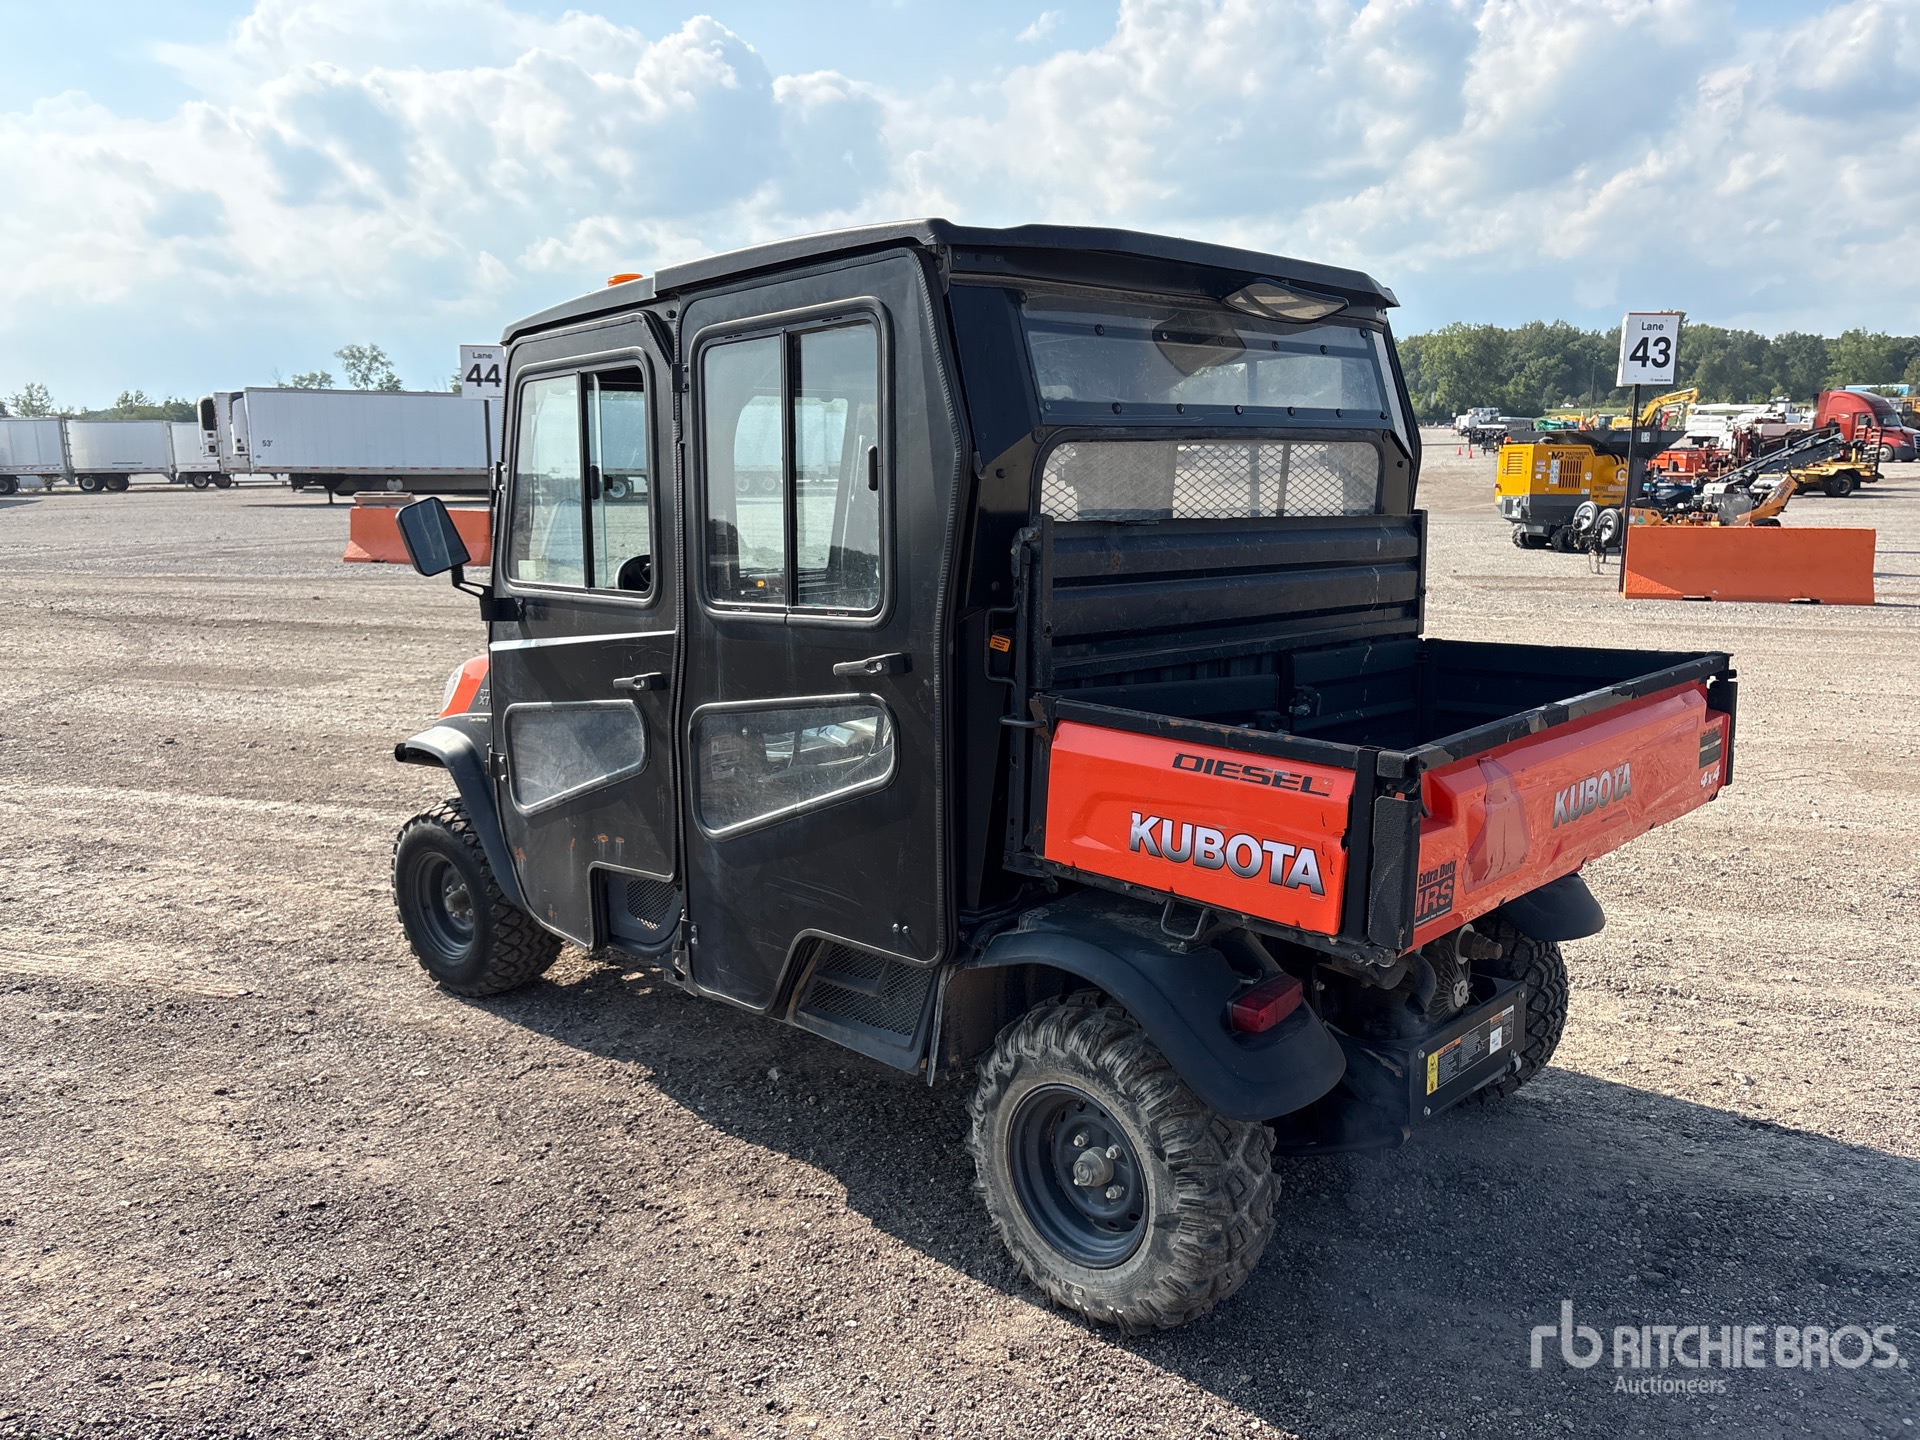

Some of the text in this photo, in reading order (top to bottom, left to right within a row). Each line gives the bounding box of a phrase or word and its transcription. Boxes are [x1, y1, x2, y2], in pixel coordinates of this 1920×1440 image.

[1641, 321, 1665, 331] Lane
[472, 351, 493, 359] Lane
[1629, 336, 1671, 368] 43
[465, 363, 502, 388] 44
[1172, 752, 1330, 797] DIESEL
[1552, 761, 1631, 829] KUBOTA
[1129, 810, 1326, 896] KUBOTA
[1419, 859, 1457, 887] Extra Duty
[1416, 879, 1453, 917] IRS
